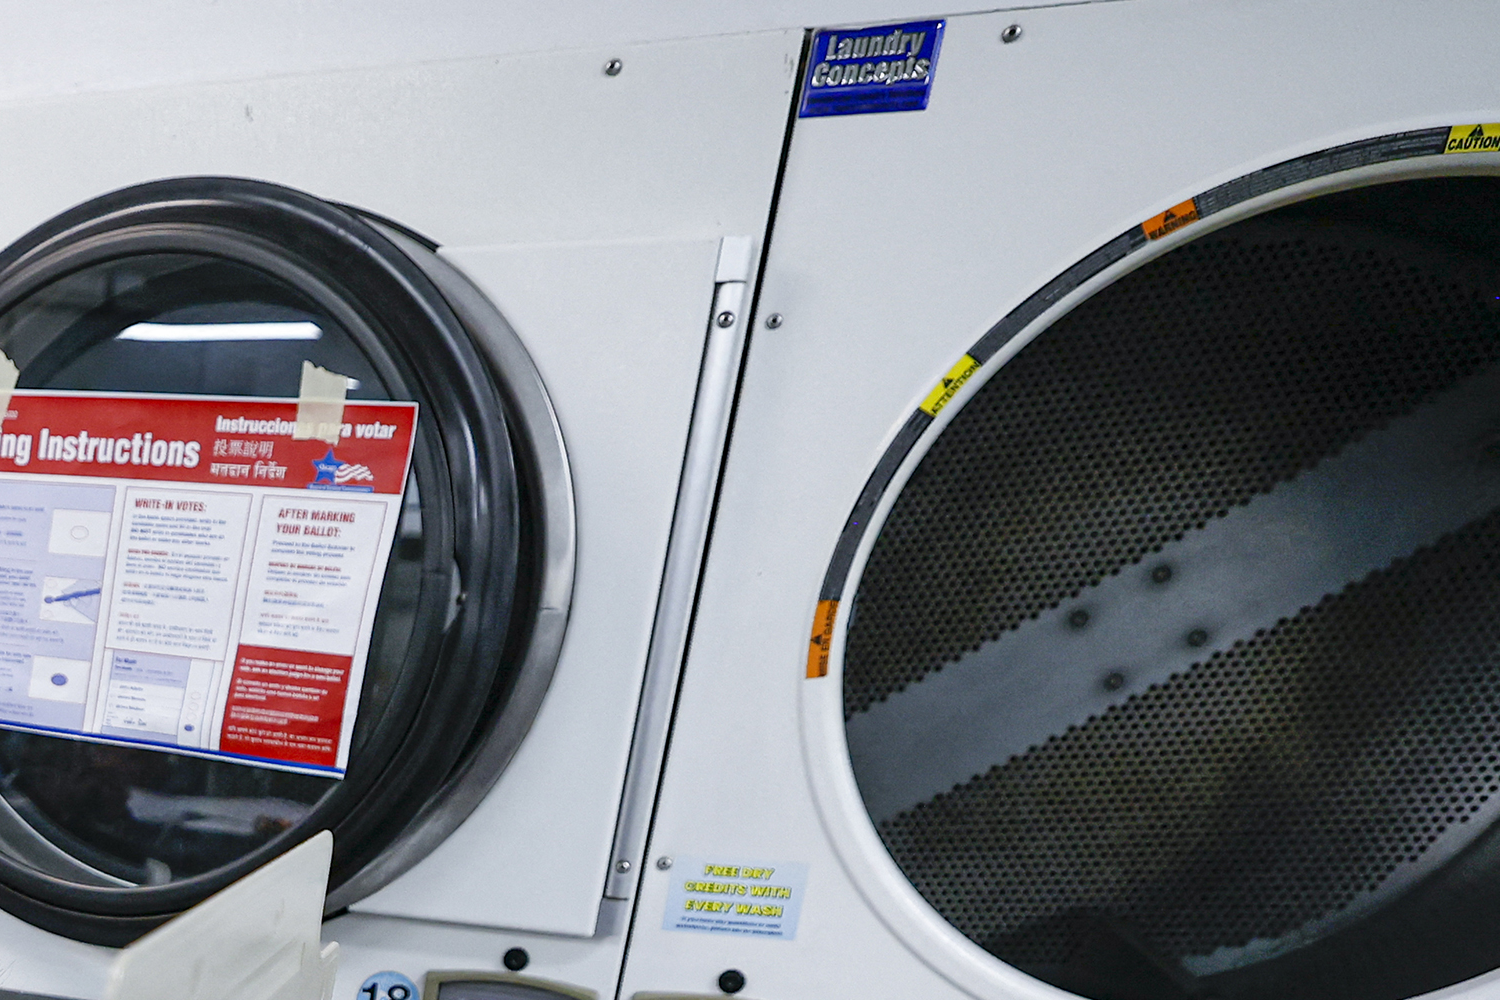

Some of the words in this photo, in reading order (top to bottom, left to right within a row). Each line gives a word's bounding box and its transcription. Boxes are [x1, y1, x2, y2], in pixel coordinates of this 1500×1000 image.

[825, 29, 926, 61] Laundry
[811, 57, 930, 87] Concepts
[1448, 136, 1500, 151] CAUTION
[216, 415, 313, 437] Instruccion
[355, 421, 396, 439] votar
[38, 428, 201, 468] Instructions
[135, 498, 173, 510] WRITE-IN
[176, 500, 207, 512] VOTES:
[278, 508, 308, 520] AFTER
[311, 510, 356, 523] MARKING
[276, 523, 301, 535] YOUR
[304, 525, 341, 538] BALLOT:
[704, 864, 740, 878] FREE
[741, 867, 775, 880] DRY
[684, 881, 747, 896] CREDITS
[750, 885, 792, 899] WITH
[684, 899, 734, 914] EVERY
[735, 902, 783, 918] WASH
